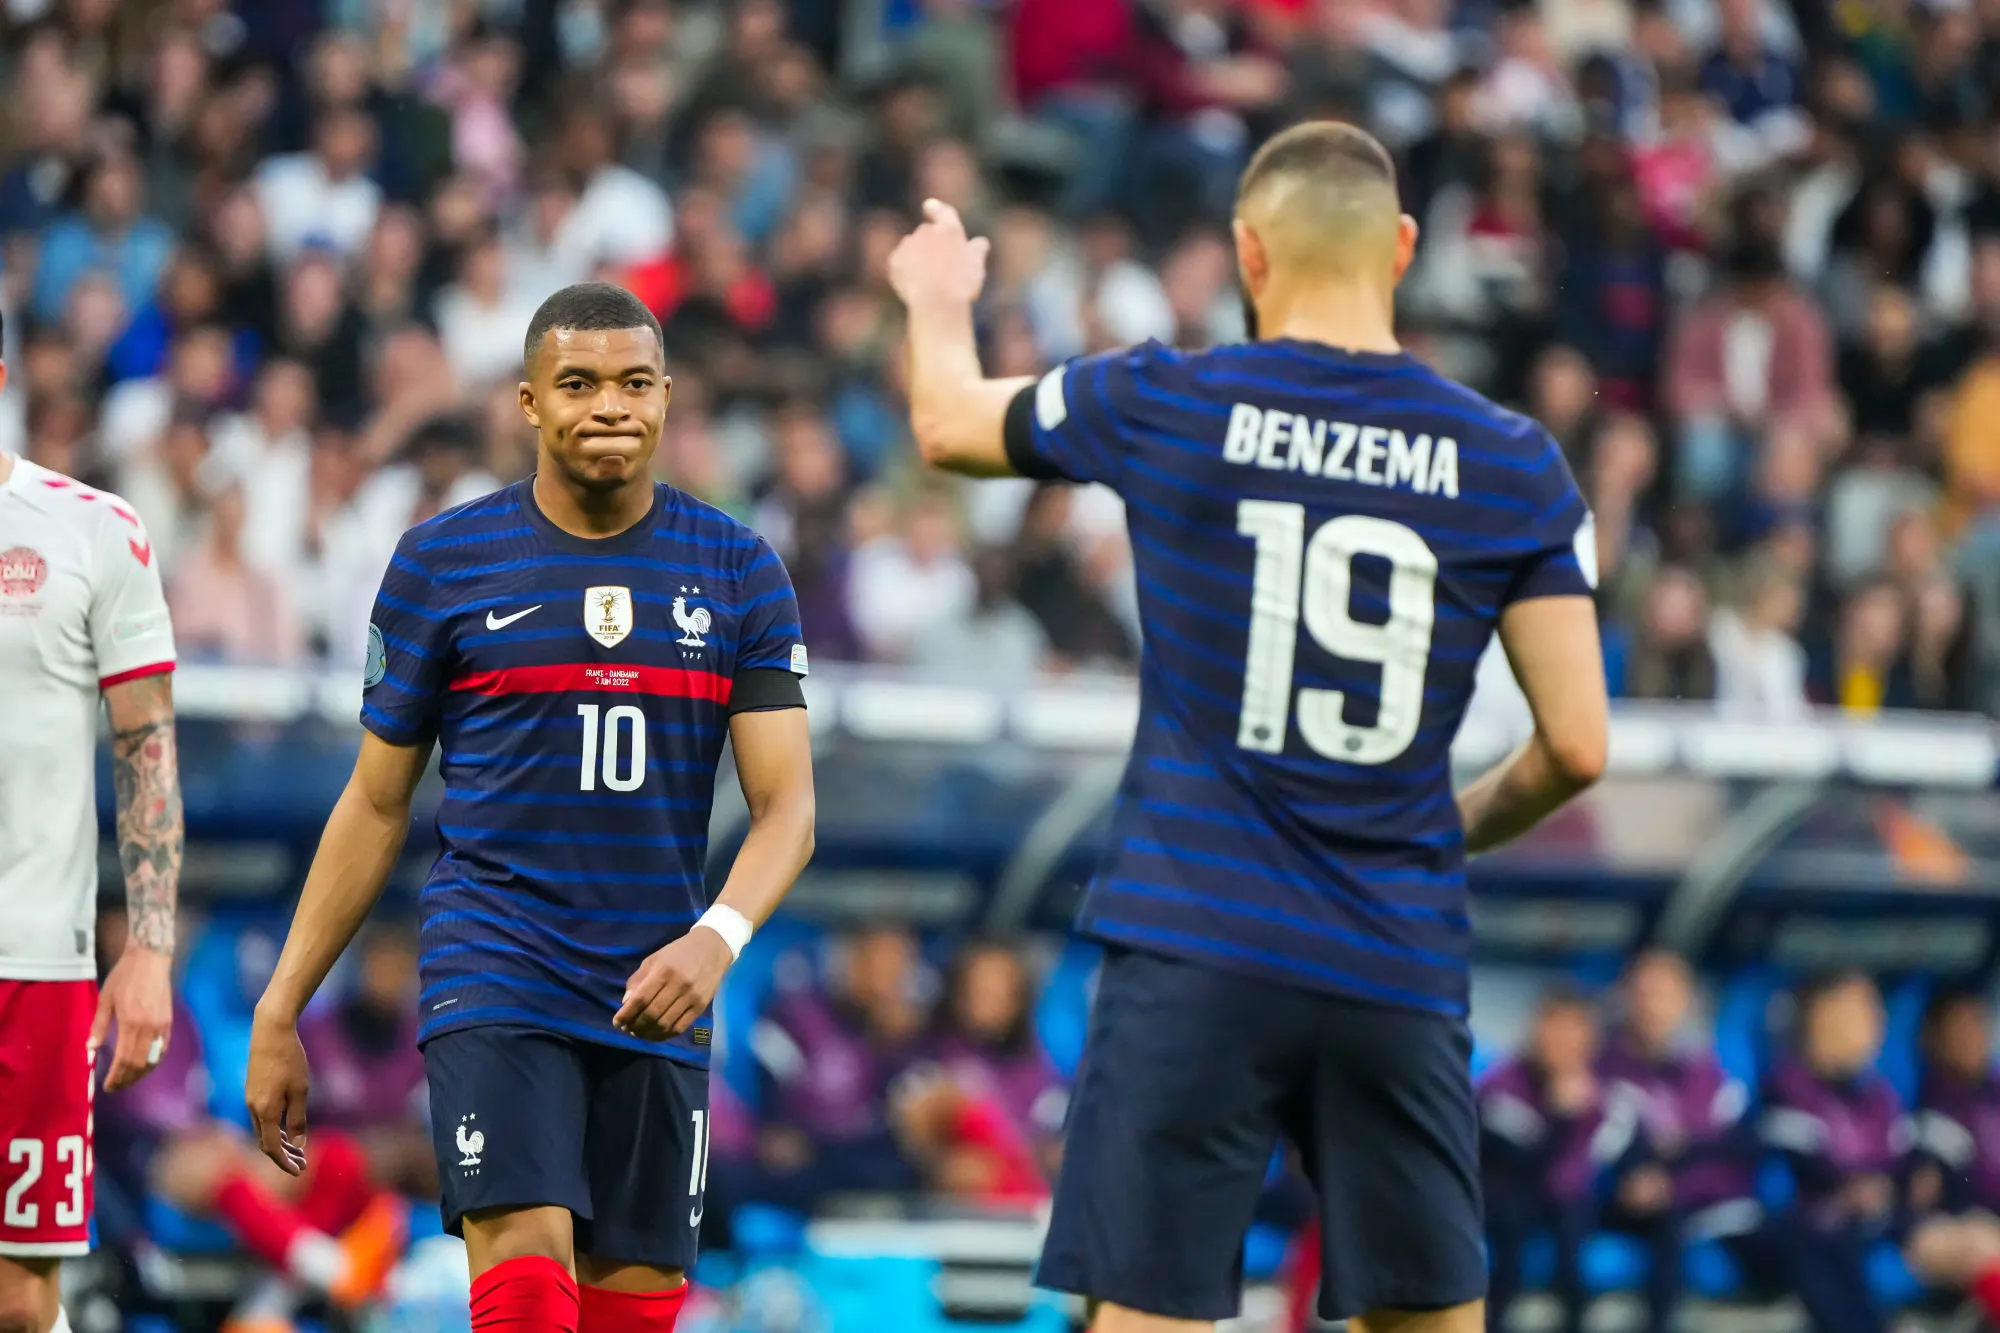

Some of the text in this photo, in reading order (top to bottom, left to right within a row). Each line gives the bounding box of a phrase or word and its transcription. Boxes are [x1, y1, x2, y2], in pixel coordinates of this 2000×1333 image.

[1222, 402, 1460, 499] BENZEMA
[599, 624, 619, 632] FIFA
[1236, 498, 1438, 766] 19
[585, 669, 604, 677] FRANCE
[609, 670, 640, 679] DANEMARK
[595, 677, 600, 685] 3
[612, 678, 630, 686] 2022
[577, 703, 646, 792] 10
[4, 1134, 84, 1229] 23
[688, 1109, 710, 1196] 1
